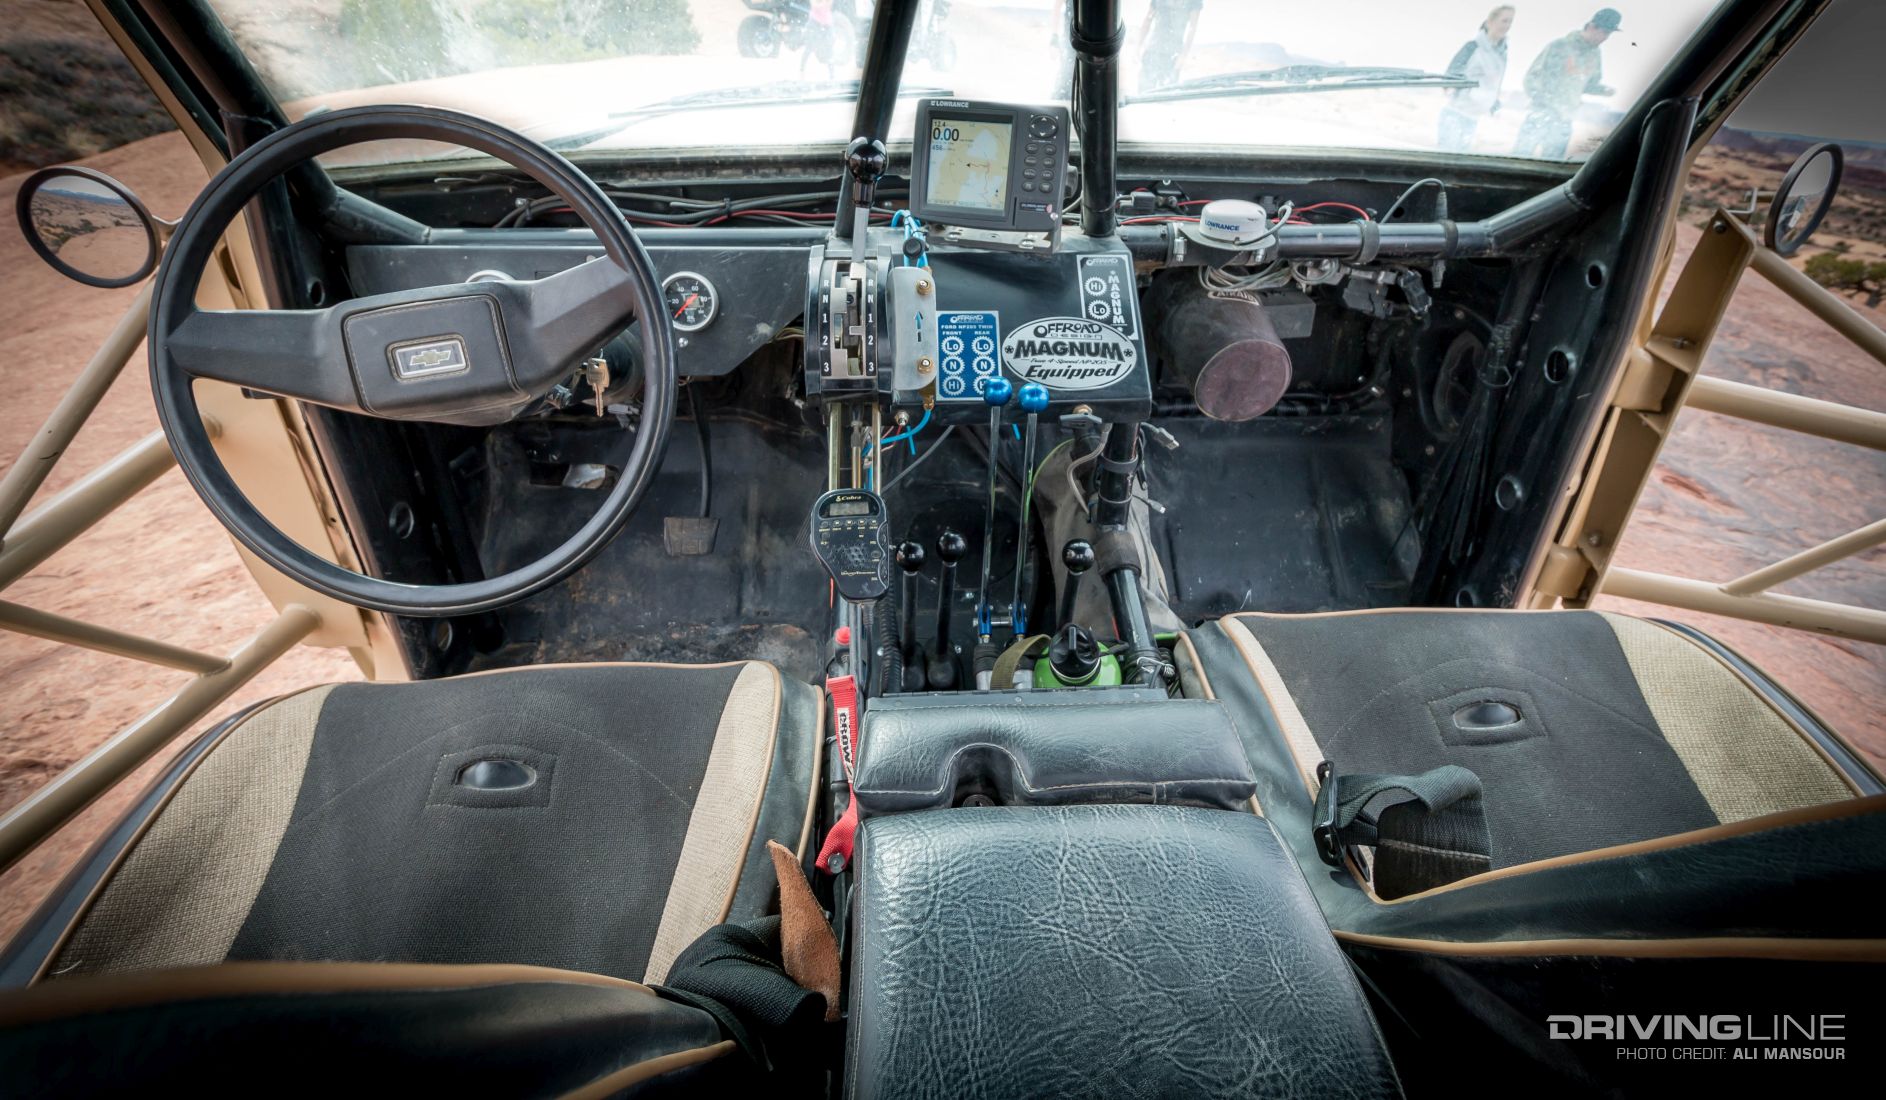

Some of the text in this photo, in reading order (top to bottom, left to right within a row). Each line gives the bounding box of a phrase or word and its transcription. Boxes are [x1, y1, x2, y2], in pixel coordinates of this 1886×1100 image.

[936, 100, 969, 108] LOWRANCE
[933, 127, 960, 141] 0.00
[1205, 219, 1240, 231] LOWRANCE
[1090, 282, 1101, 291] Hi
[1108, 275, 1125, 324] MAGNUM
[1094, 305, 1106, 314] Lo
[1033, 322, 1103, 338] OFFROAD
[947, 342, 959, 350] Lo
[977, 342, 989, 350] Lo
[1013, 340, 1125, 362] MAGNUM
[949, 361, 957, 370] N
[980, 361, 988, 370] N
[1024, 363, 1122, 379] Equipped
[948, 380, 960, 390] Hi
[839, 711, 851, 763] CROW
